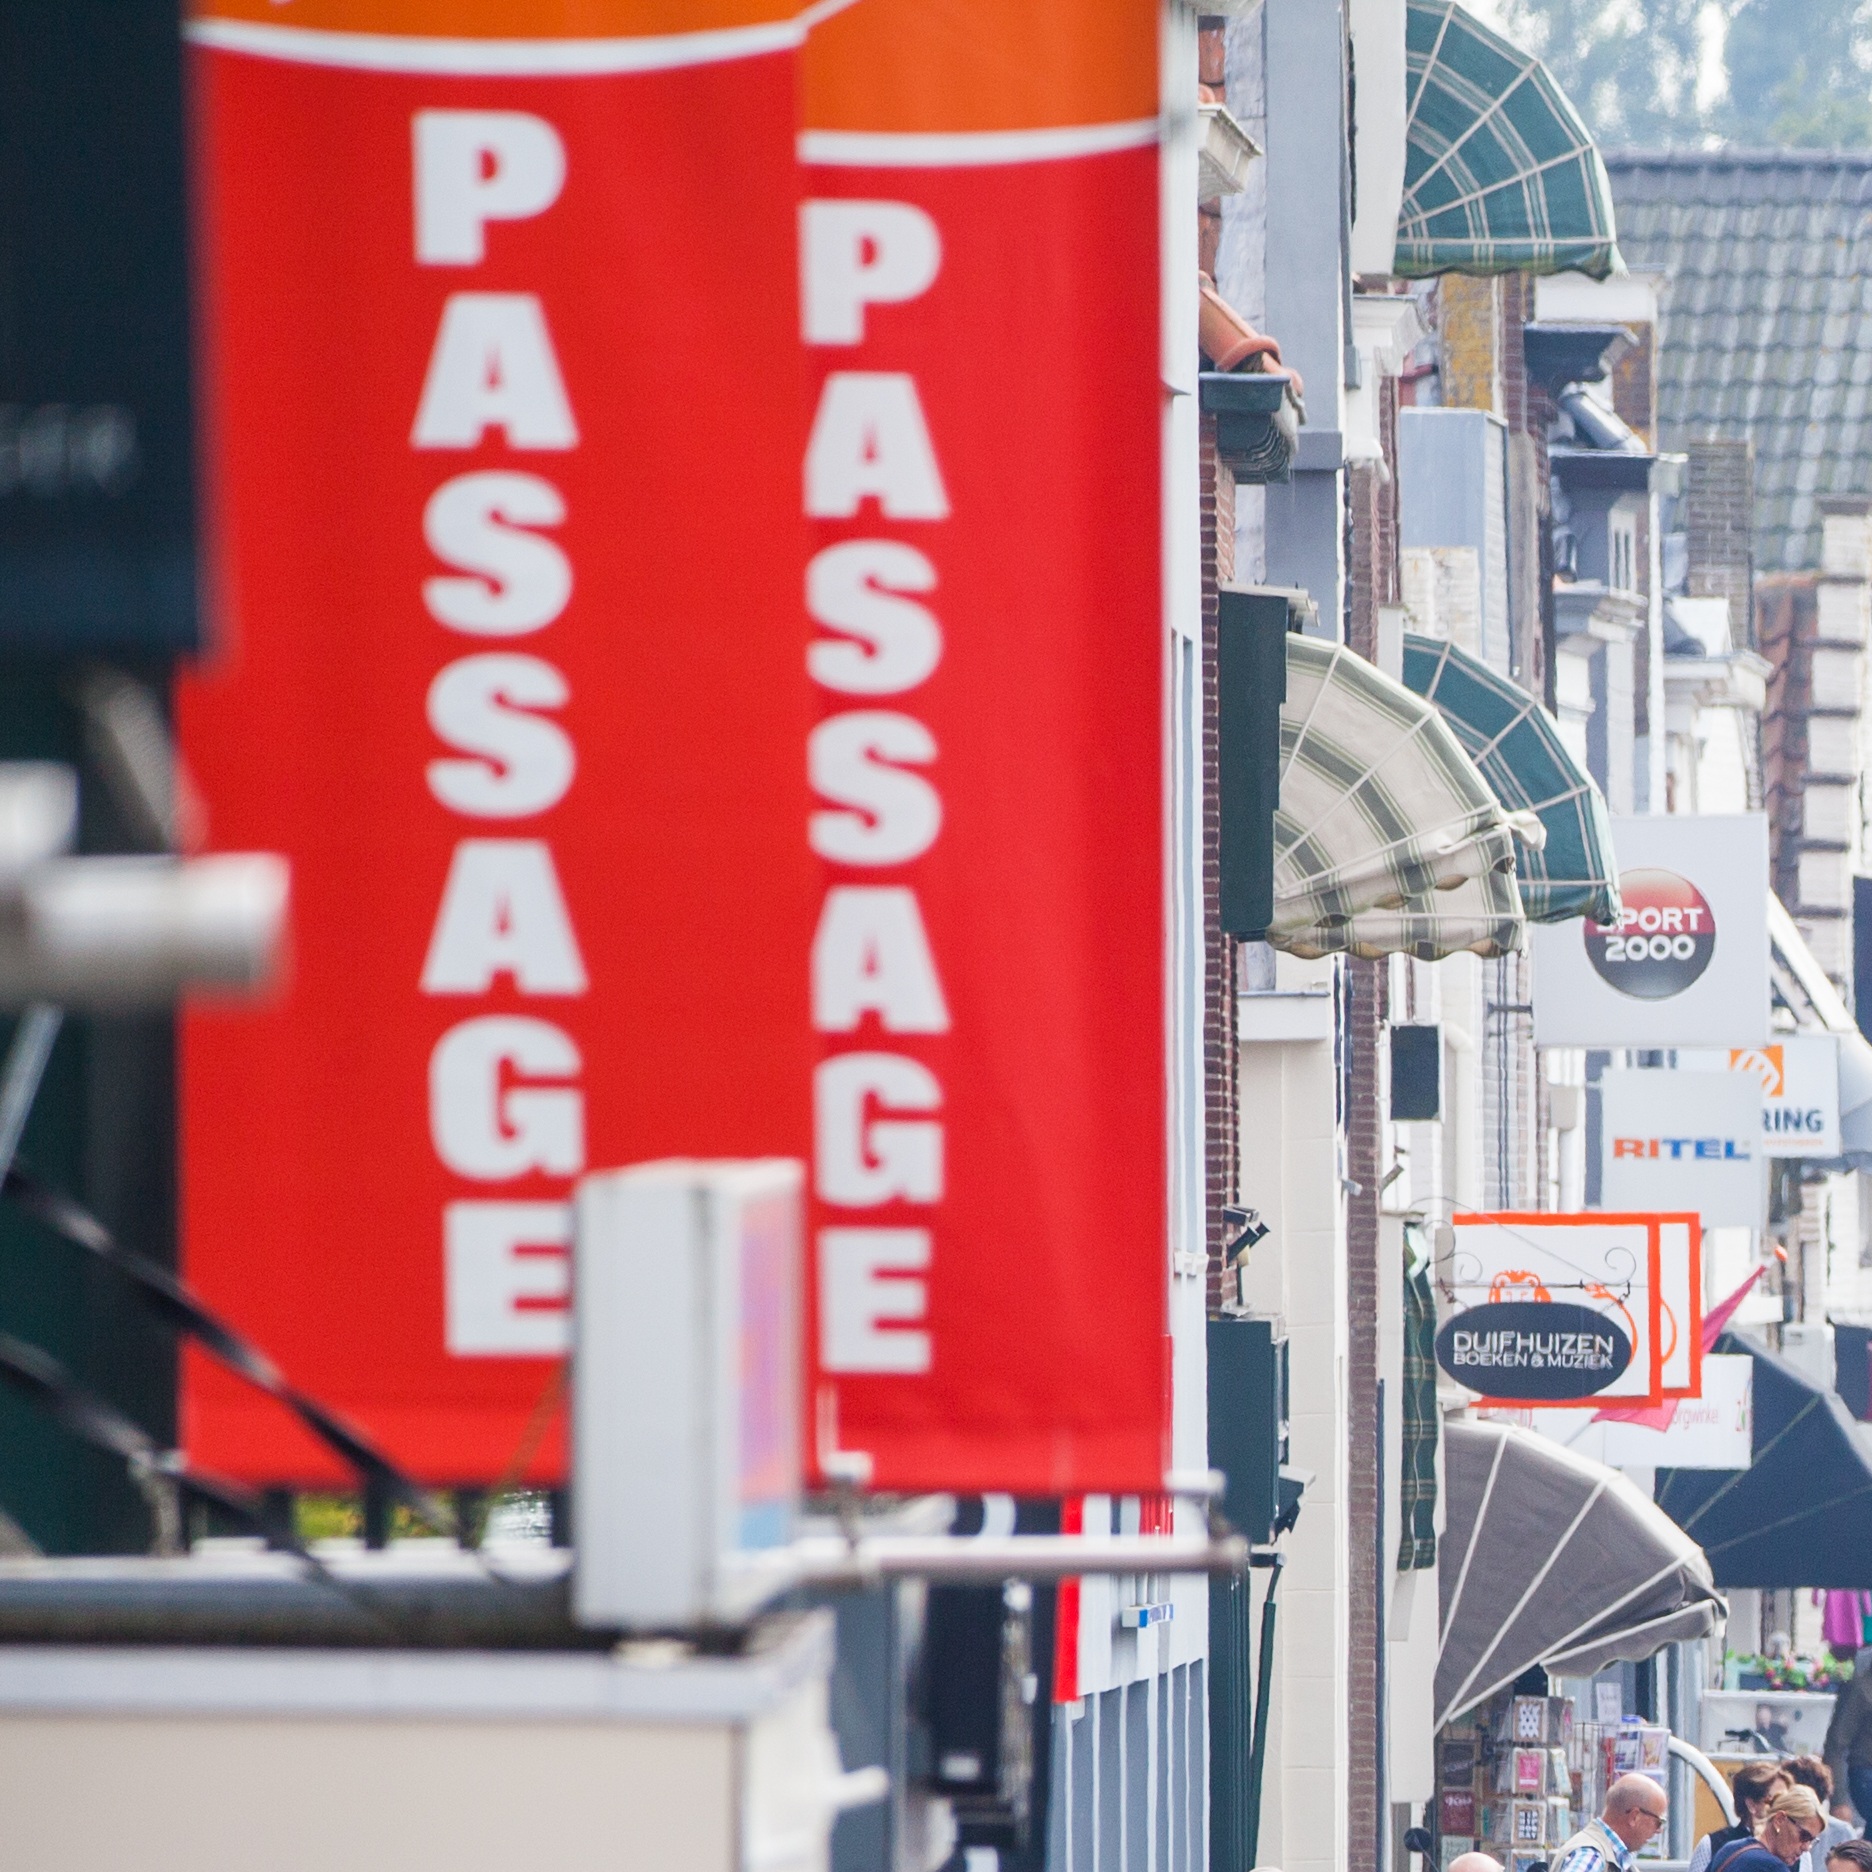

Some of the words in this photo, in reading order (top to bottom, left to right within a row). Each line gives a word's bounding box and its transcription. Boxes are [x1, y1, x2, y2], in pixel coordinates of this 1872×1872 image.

[410, 107, 589, 1358] PASSAGE
[798, 198, 952, 1376] PASSAGE
[1605, 935, 1696, 962] 2000
[1612, 1138, 1751, 1159] RITEL
[1453, 1330, 1614, 1356] DUIFHUIZEN
[1453, 1351, 1527, 1367] BOEKEN
[1530, 1354, 1544, 1368] &
[1547, 1353, 1614, 1370] MUZIEK
